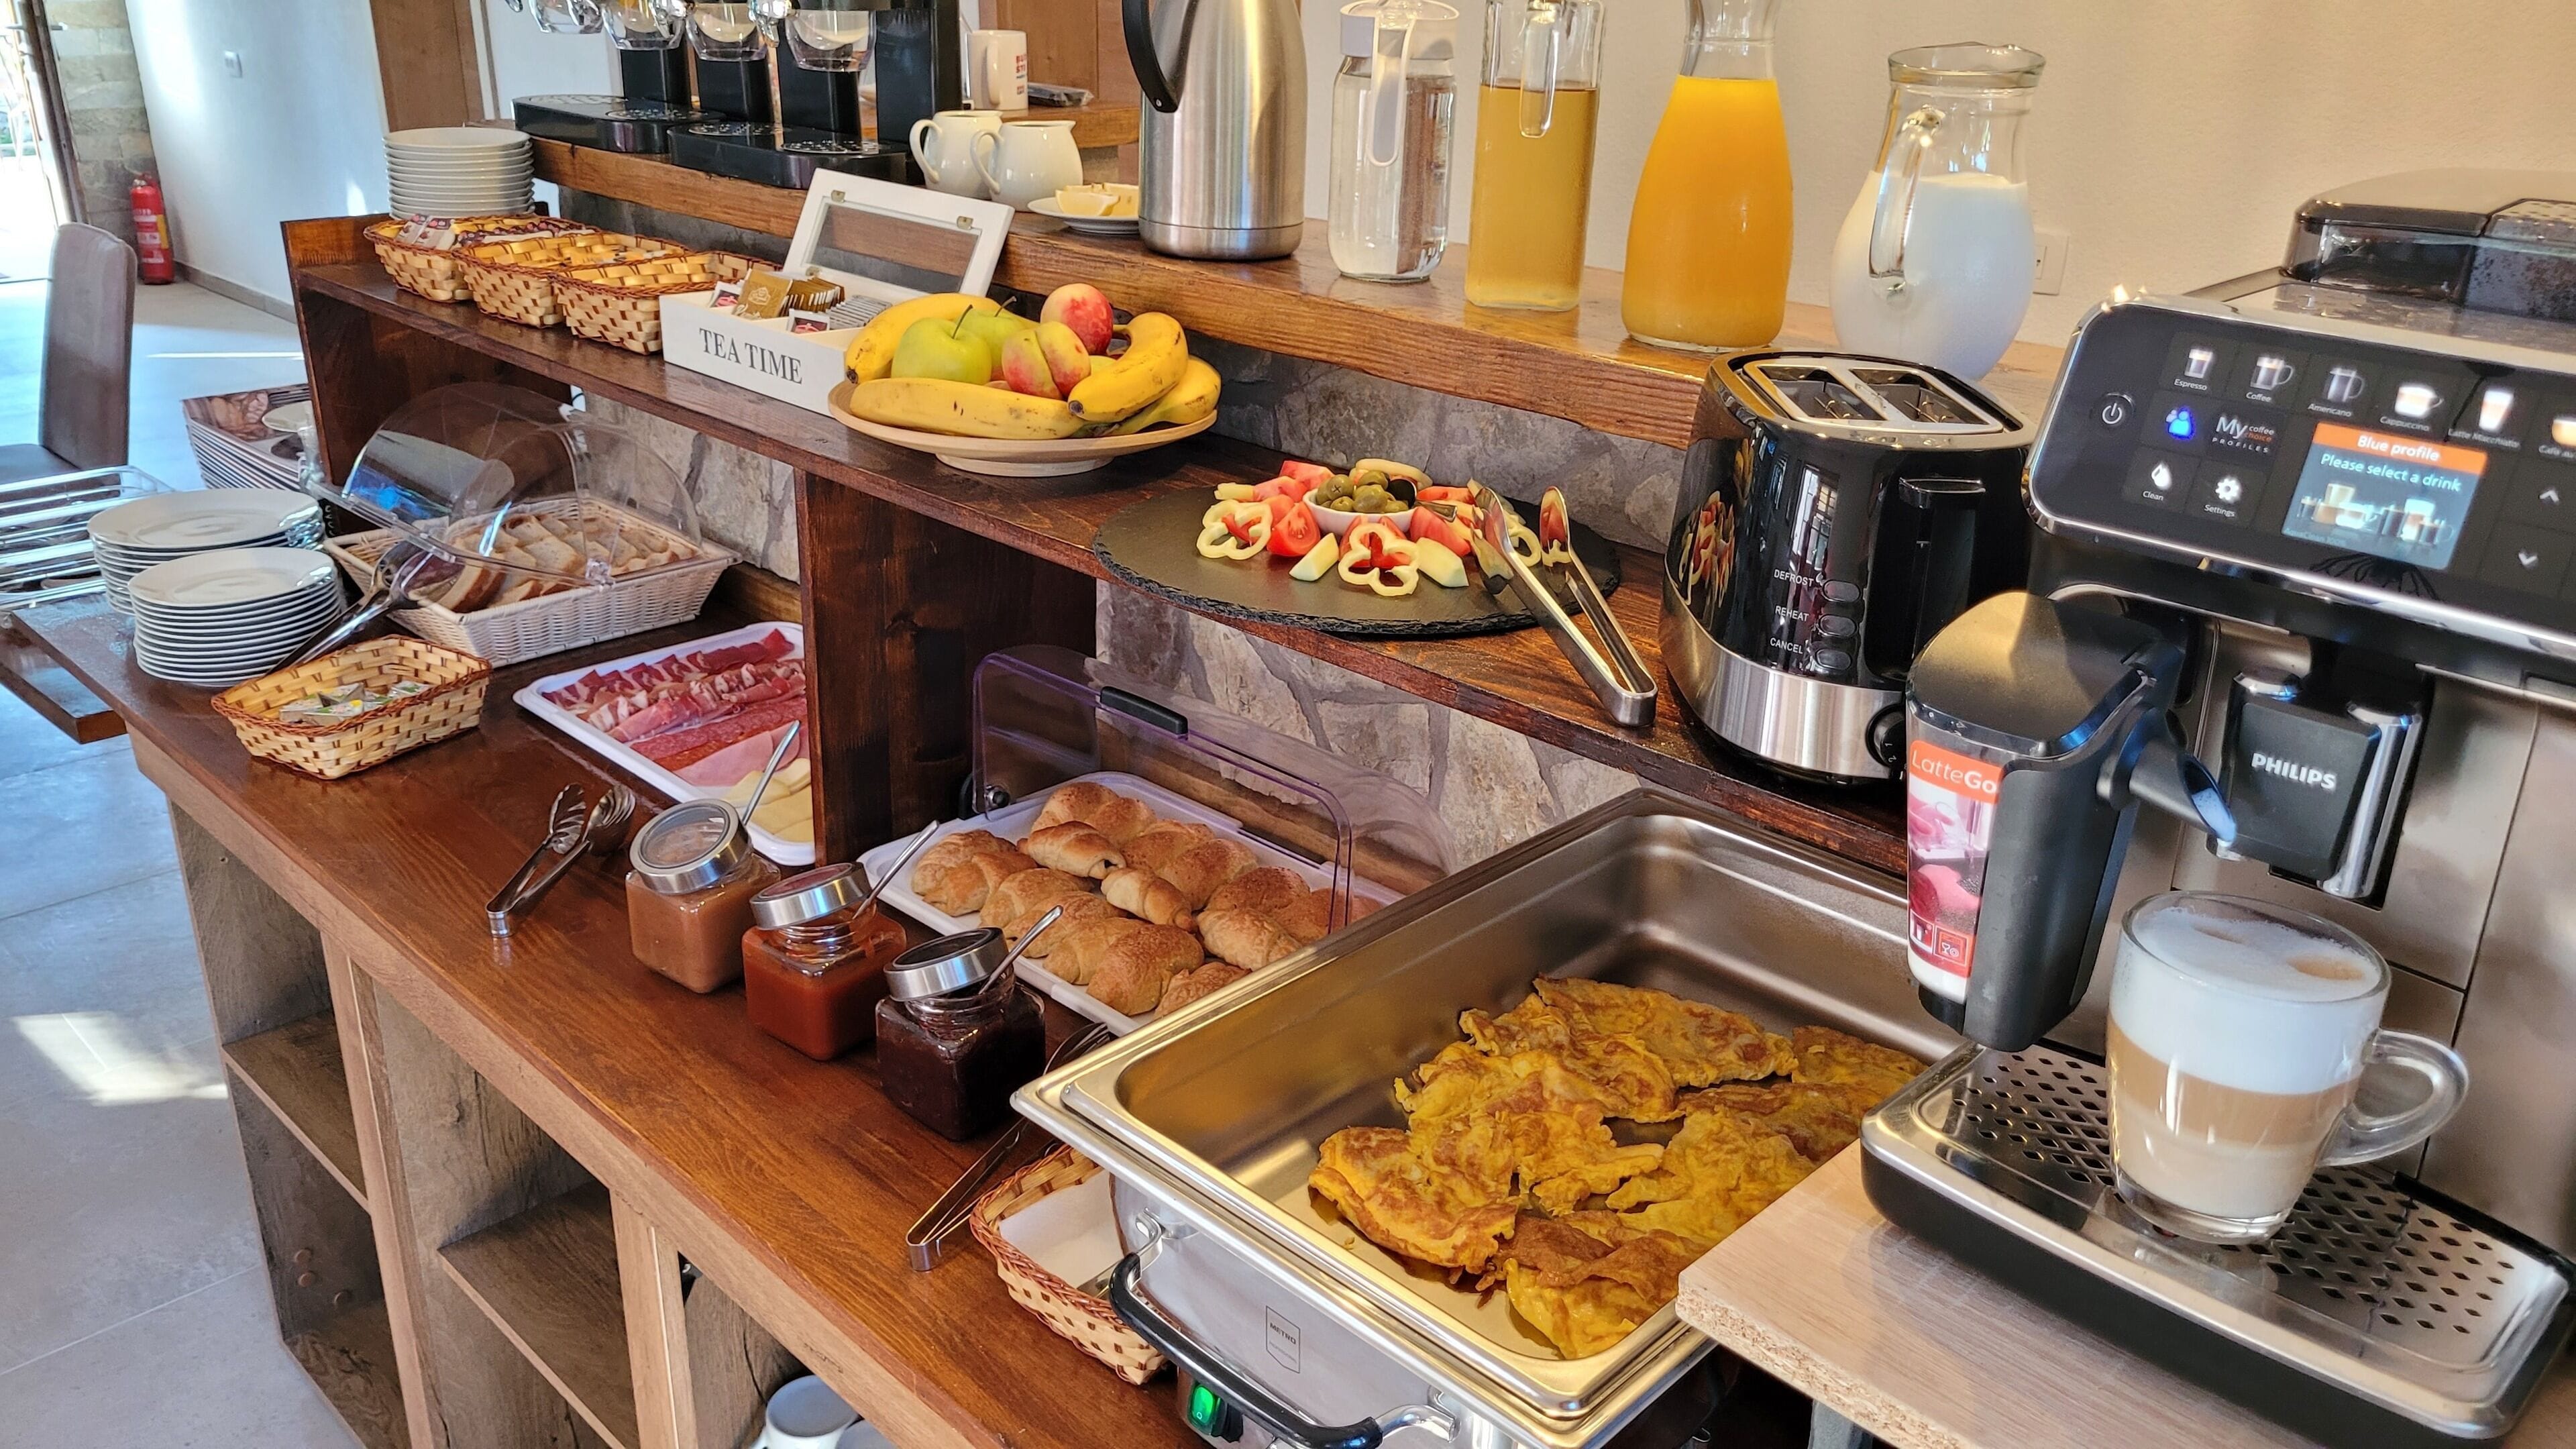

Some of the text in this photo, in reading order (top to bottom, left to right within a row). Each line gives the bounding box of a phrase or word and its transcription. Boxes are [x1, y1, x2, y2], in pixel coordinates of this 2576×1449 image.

[700, 328, 802, 384] TEA TIME
[2174, 378, 2208, 390] Espresso
[2246, 392, 2271, 402] Coffee
[2308, 403, 2352, 417] Americano
[2216, 416, 2275, 439] My coffee
[2379, 416, 2430, 432] Cappuccino
[2212, 437, 2269, 453] PROFILES
[2357, 435, 2440, 462] Blue profile
[2320, 453, 2462, 492] Please select a drink
[2143, 490, 2164, 501] Clean
[2204, 504, 2235, 517] Settings
[1774, 569, 1814, 587] DEFROST
[1775, 606, 1809, 622] REHEAT
[1770, 637, 1803, 654] CANCEL
[1912, 749, 1998, 793] LatteGo
[2251, 752, 2337, 790] PHILIPS
[1269, 1322, 1297, 1345] METRO
